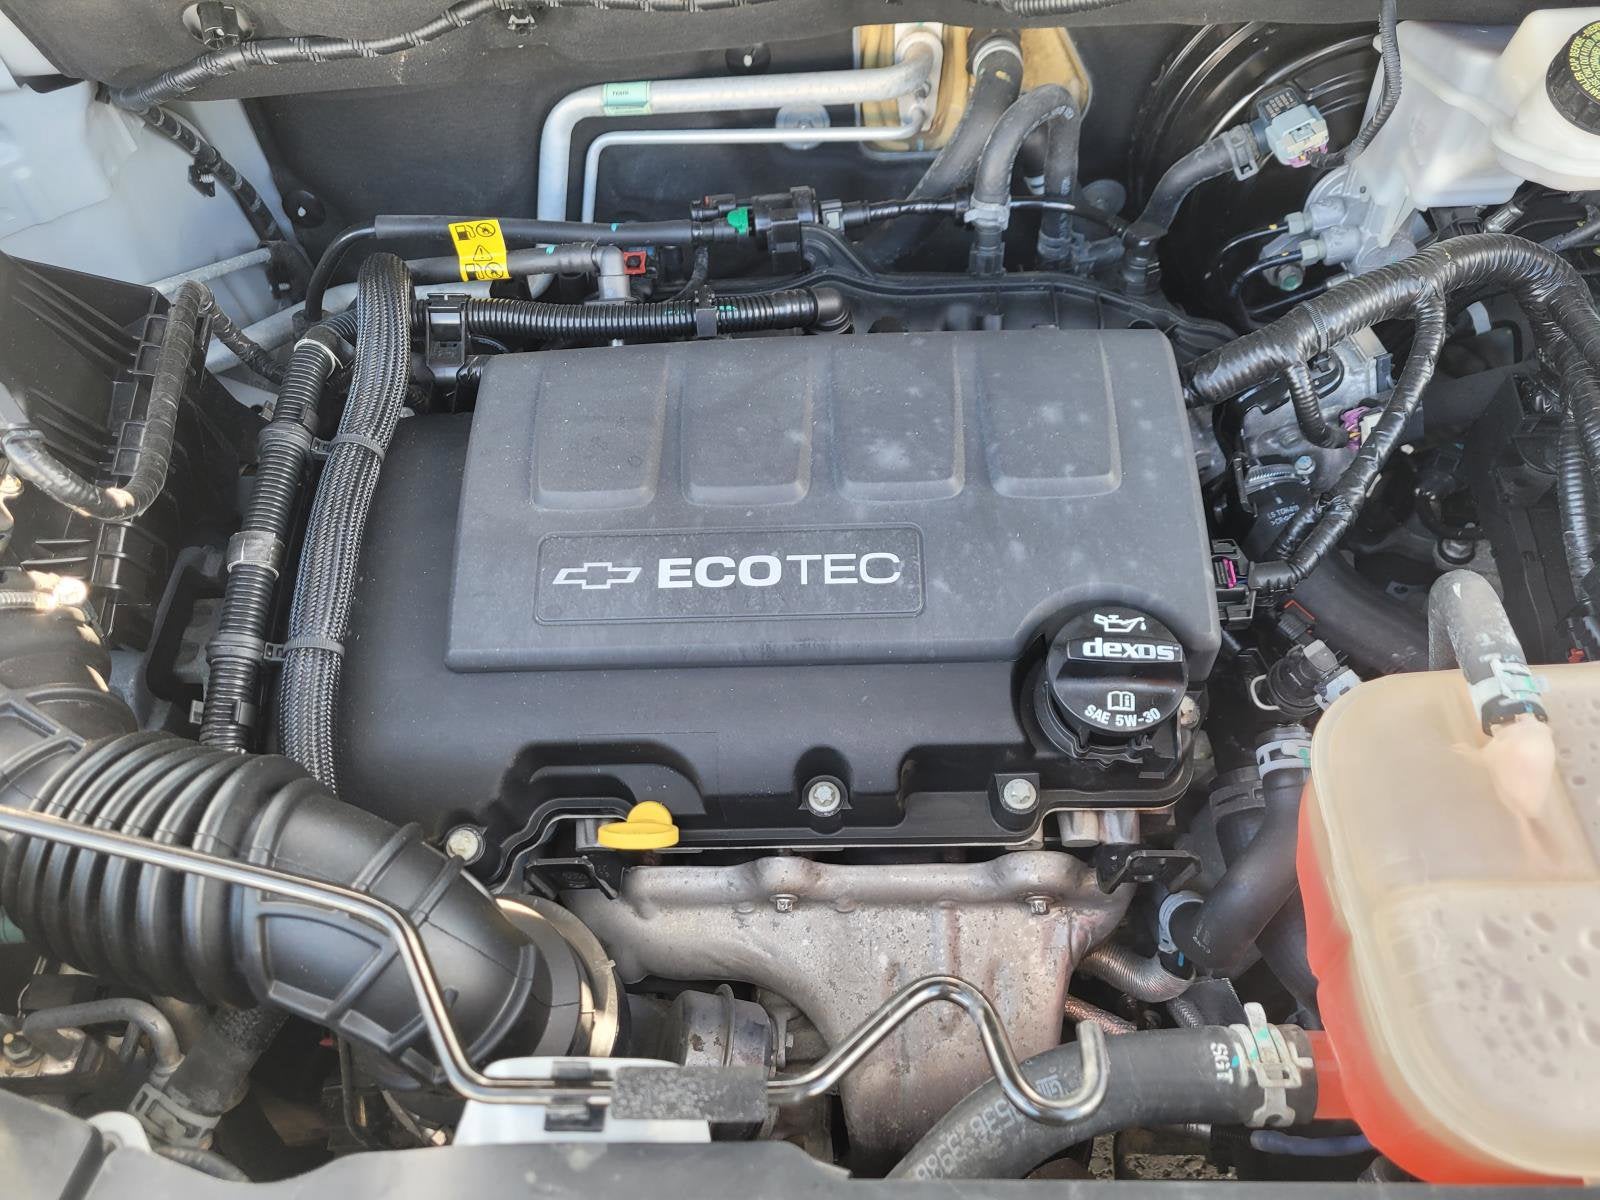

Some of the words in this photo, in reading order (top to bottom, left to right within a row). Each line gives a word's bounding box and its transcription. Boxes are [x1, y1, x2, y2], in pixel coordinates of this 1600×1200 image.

[657, 552, 900, 589] ECOTEC
[1082, 637, 1175, 661] dexos
[1084, 704, 1111, 725] SAE
[1115, 707, 1161, 727] 5W-30
[1210, 1042, 1234, 1084] SGT
